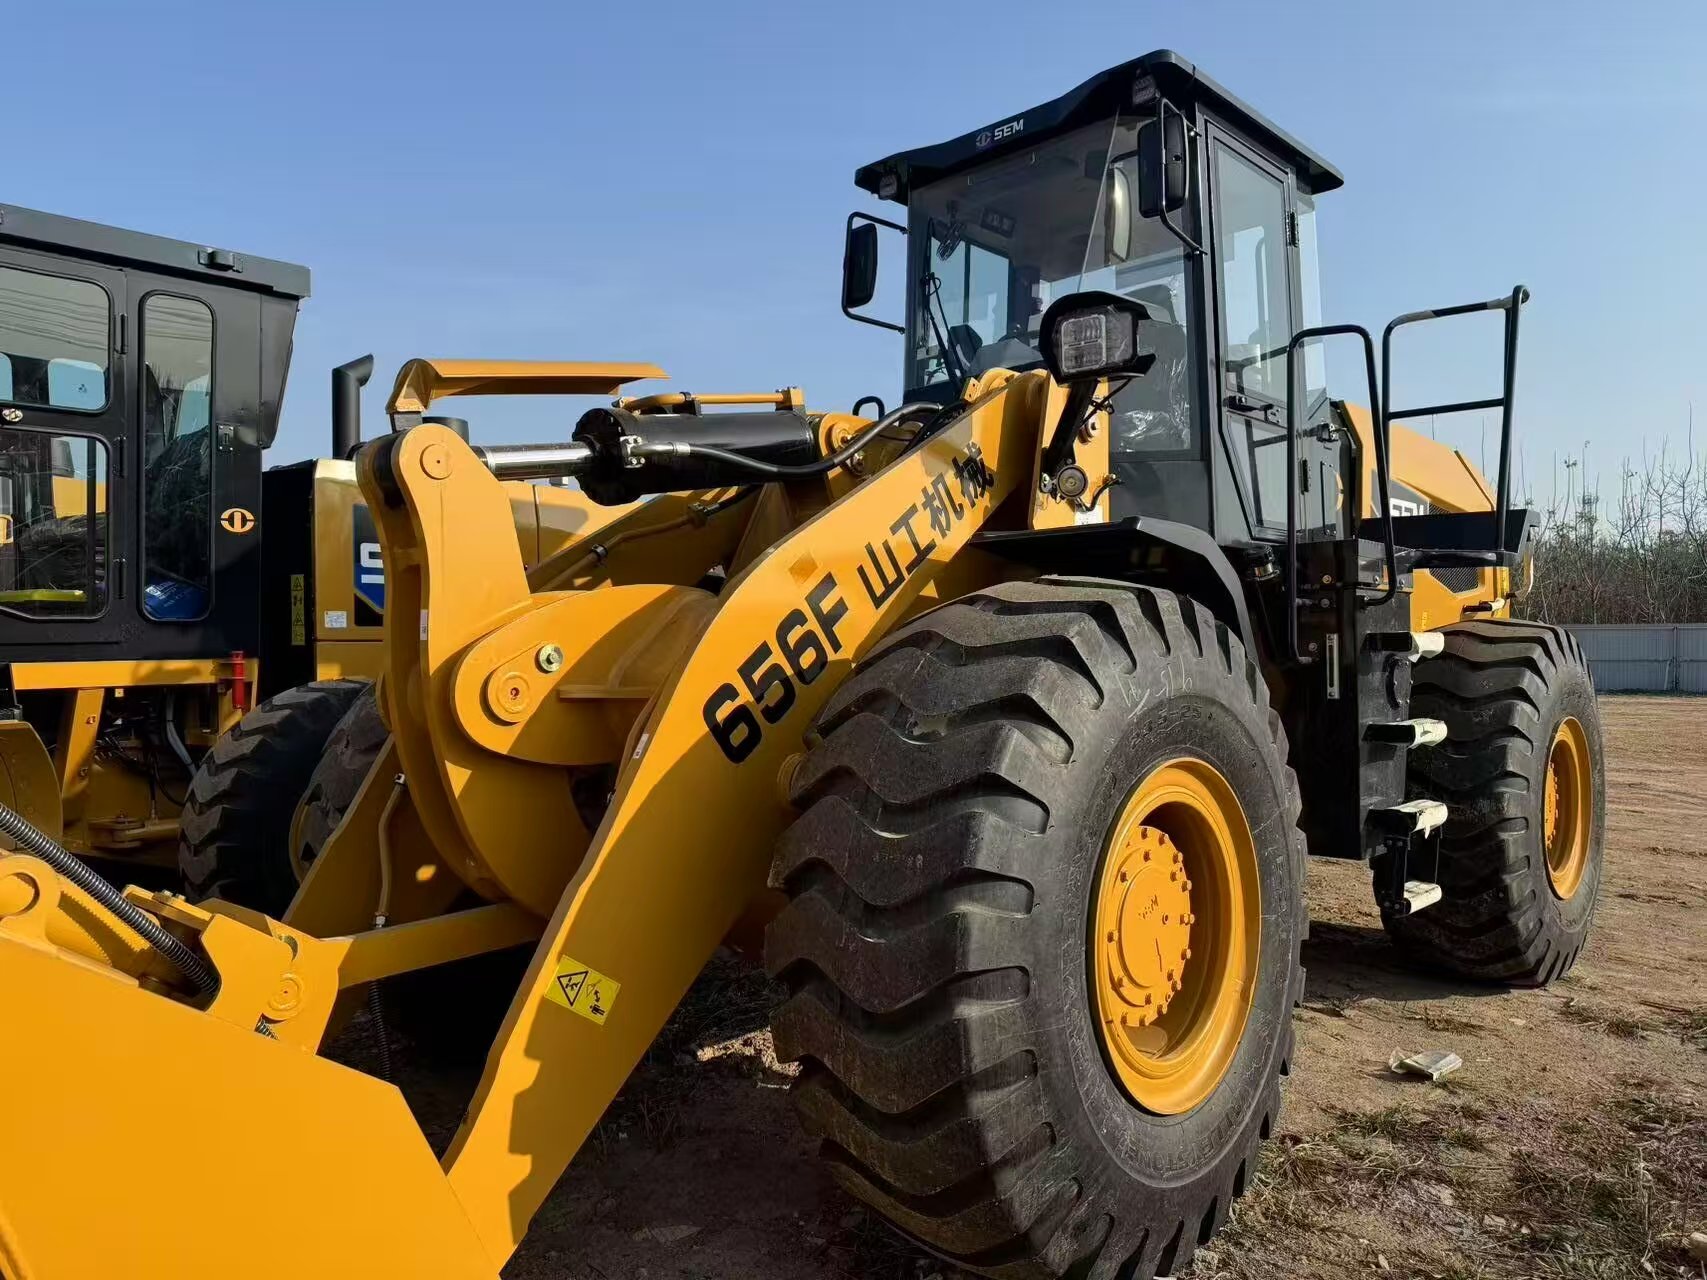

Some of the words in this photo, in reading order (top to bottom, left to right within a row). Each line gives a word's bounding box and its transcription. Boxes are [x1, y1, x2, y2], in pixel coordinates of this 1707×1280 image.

[993, 118, 1024, 141] SEM
[702, 571, 849, 764] 656F
[856, 441, 995, 611] 山工机械
